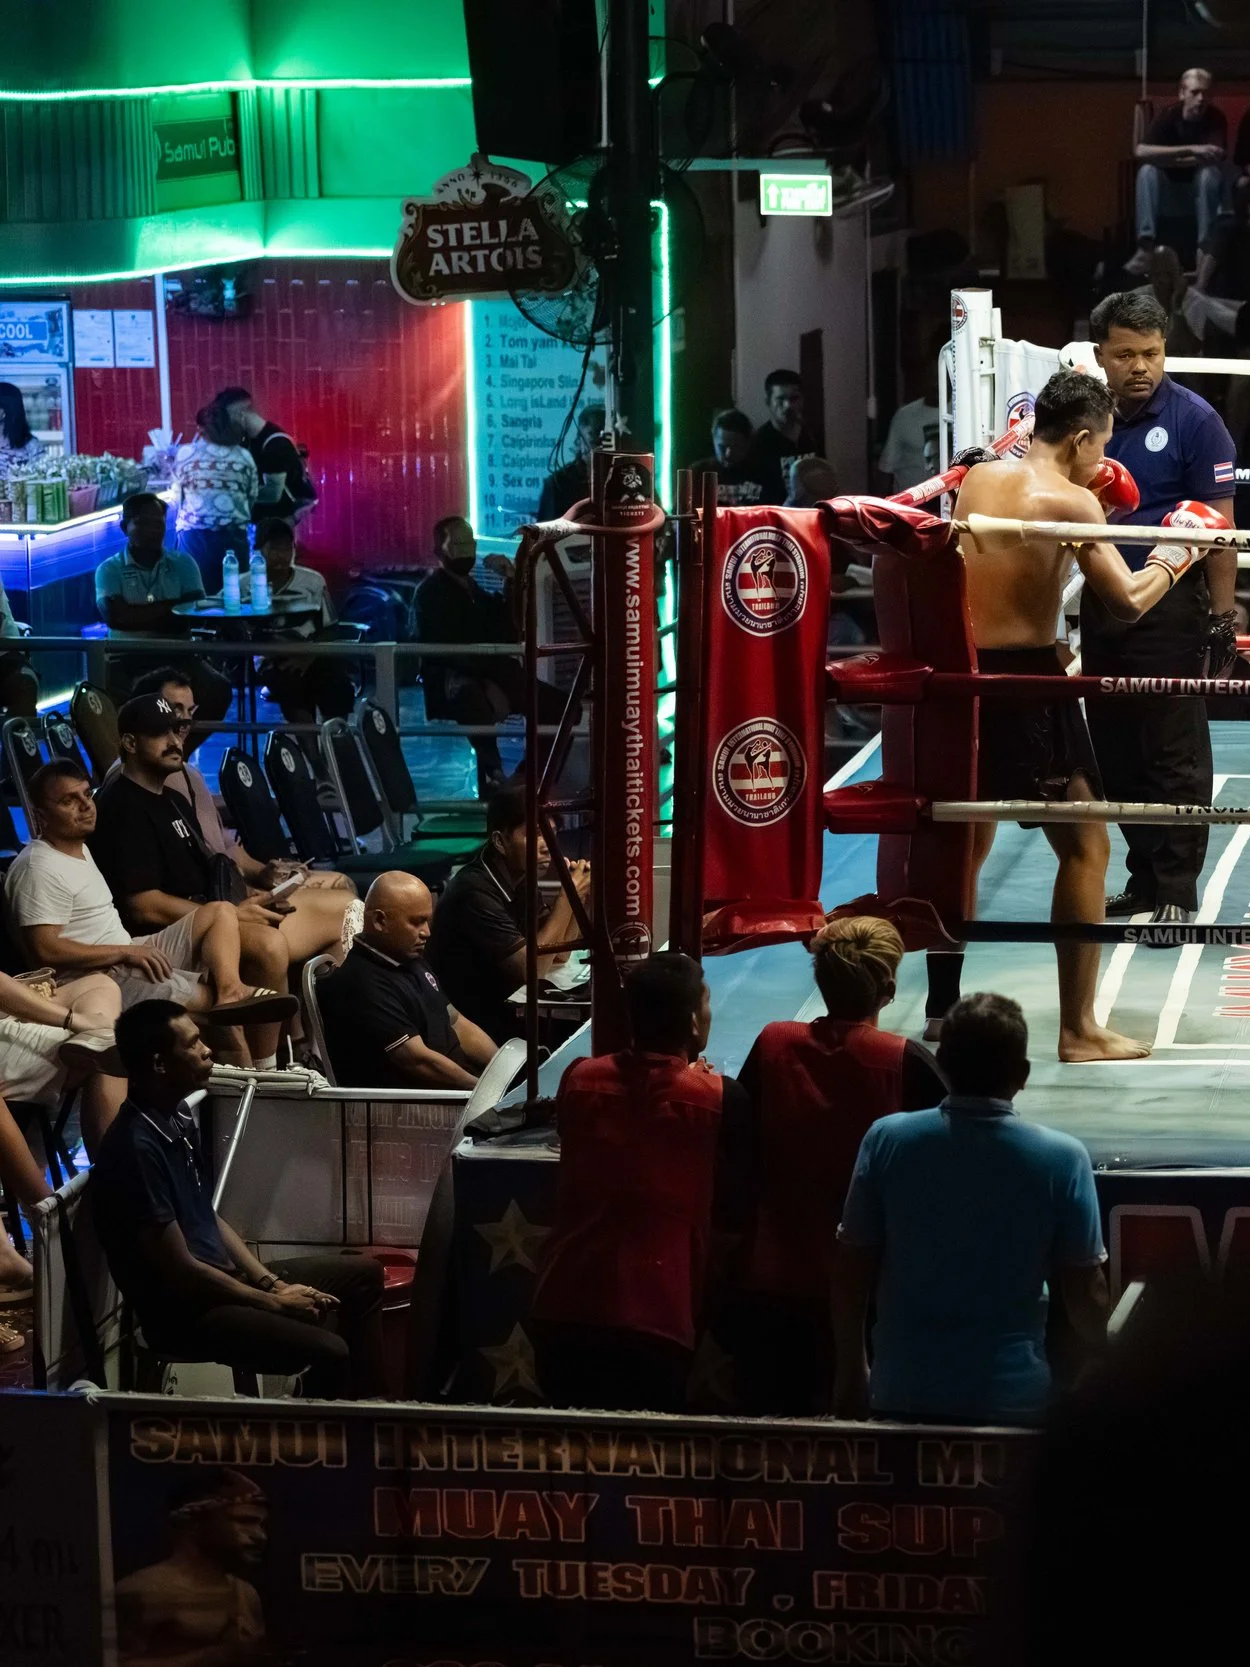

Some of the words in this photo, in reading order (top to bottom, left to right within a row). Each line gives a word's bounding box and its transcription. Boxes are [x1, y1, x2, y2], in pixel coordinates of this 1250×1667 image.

[209, 136, 235, 158] Pub
[427, 218, 540, 248] STELLA
[429, 246, 543, 277] ARTOIS
[1100, 677, 1172, 694] SAMUI
[621, 535, 644, 916] www.samuimuaythaitickets.com
[1124, 928, 1197, 945] SAMUI
[130, 1416, 348, 1468] SAMUI
[374, 1419, 893, 1486] INTERNATIONAL
[373, 1487, 599, 1544] MUAY
[625, 1495, 804, 1551] THAI
[837, 1502, 1004, 1558] SUP
[301, 1552, 492, 1596] EVERY
[512, 1559, 755, 1607] TUESDAY
[693, 1616, 979, 1666] BOOKING
